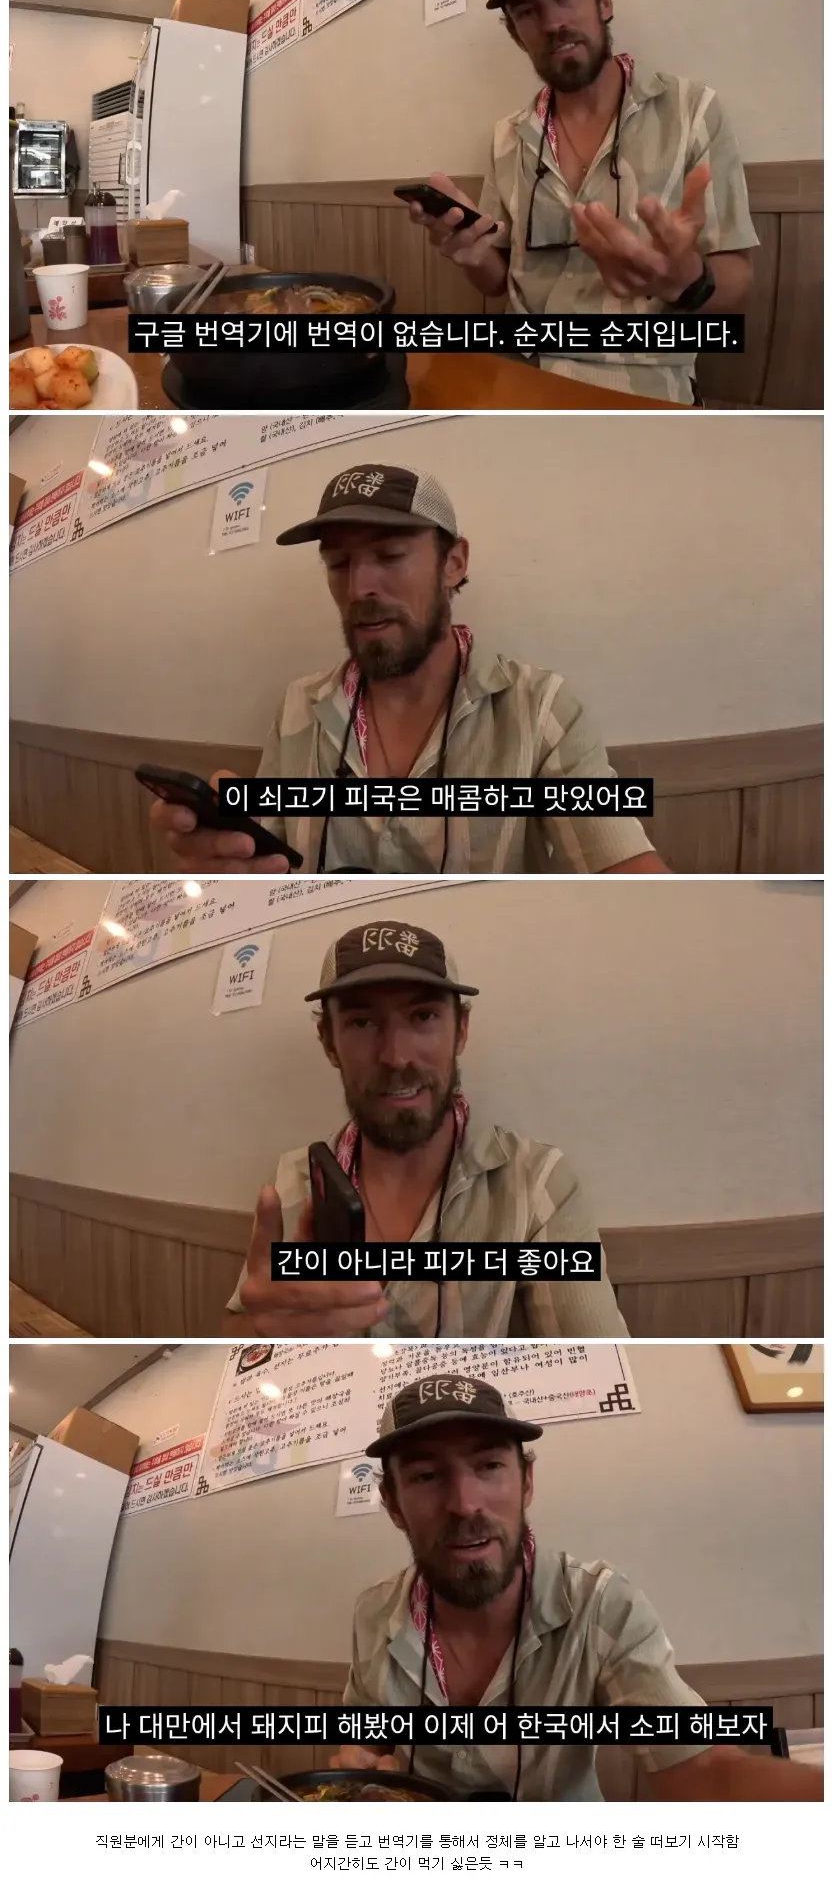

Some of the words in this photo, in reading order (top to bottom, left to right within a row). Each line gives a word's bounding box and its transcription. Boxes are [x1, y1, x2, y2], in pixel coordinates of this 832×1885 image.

[225, 507, 250, 522] WIFI
[229, 970, 255, 985] WIFI
[144, 1472, 163, 1491] 드실
[163, 1462, 193, 1485] 만큼만
[349, 1483, 371, 1495] WIFI
